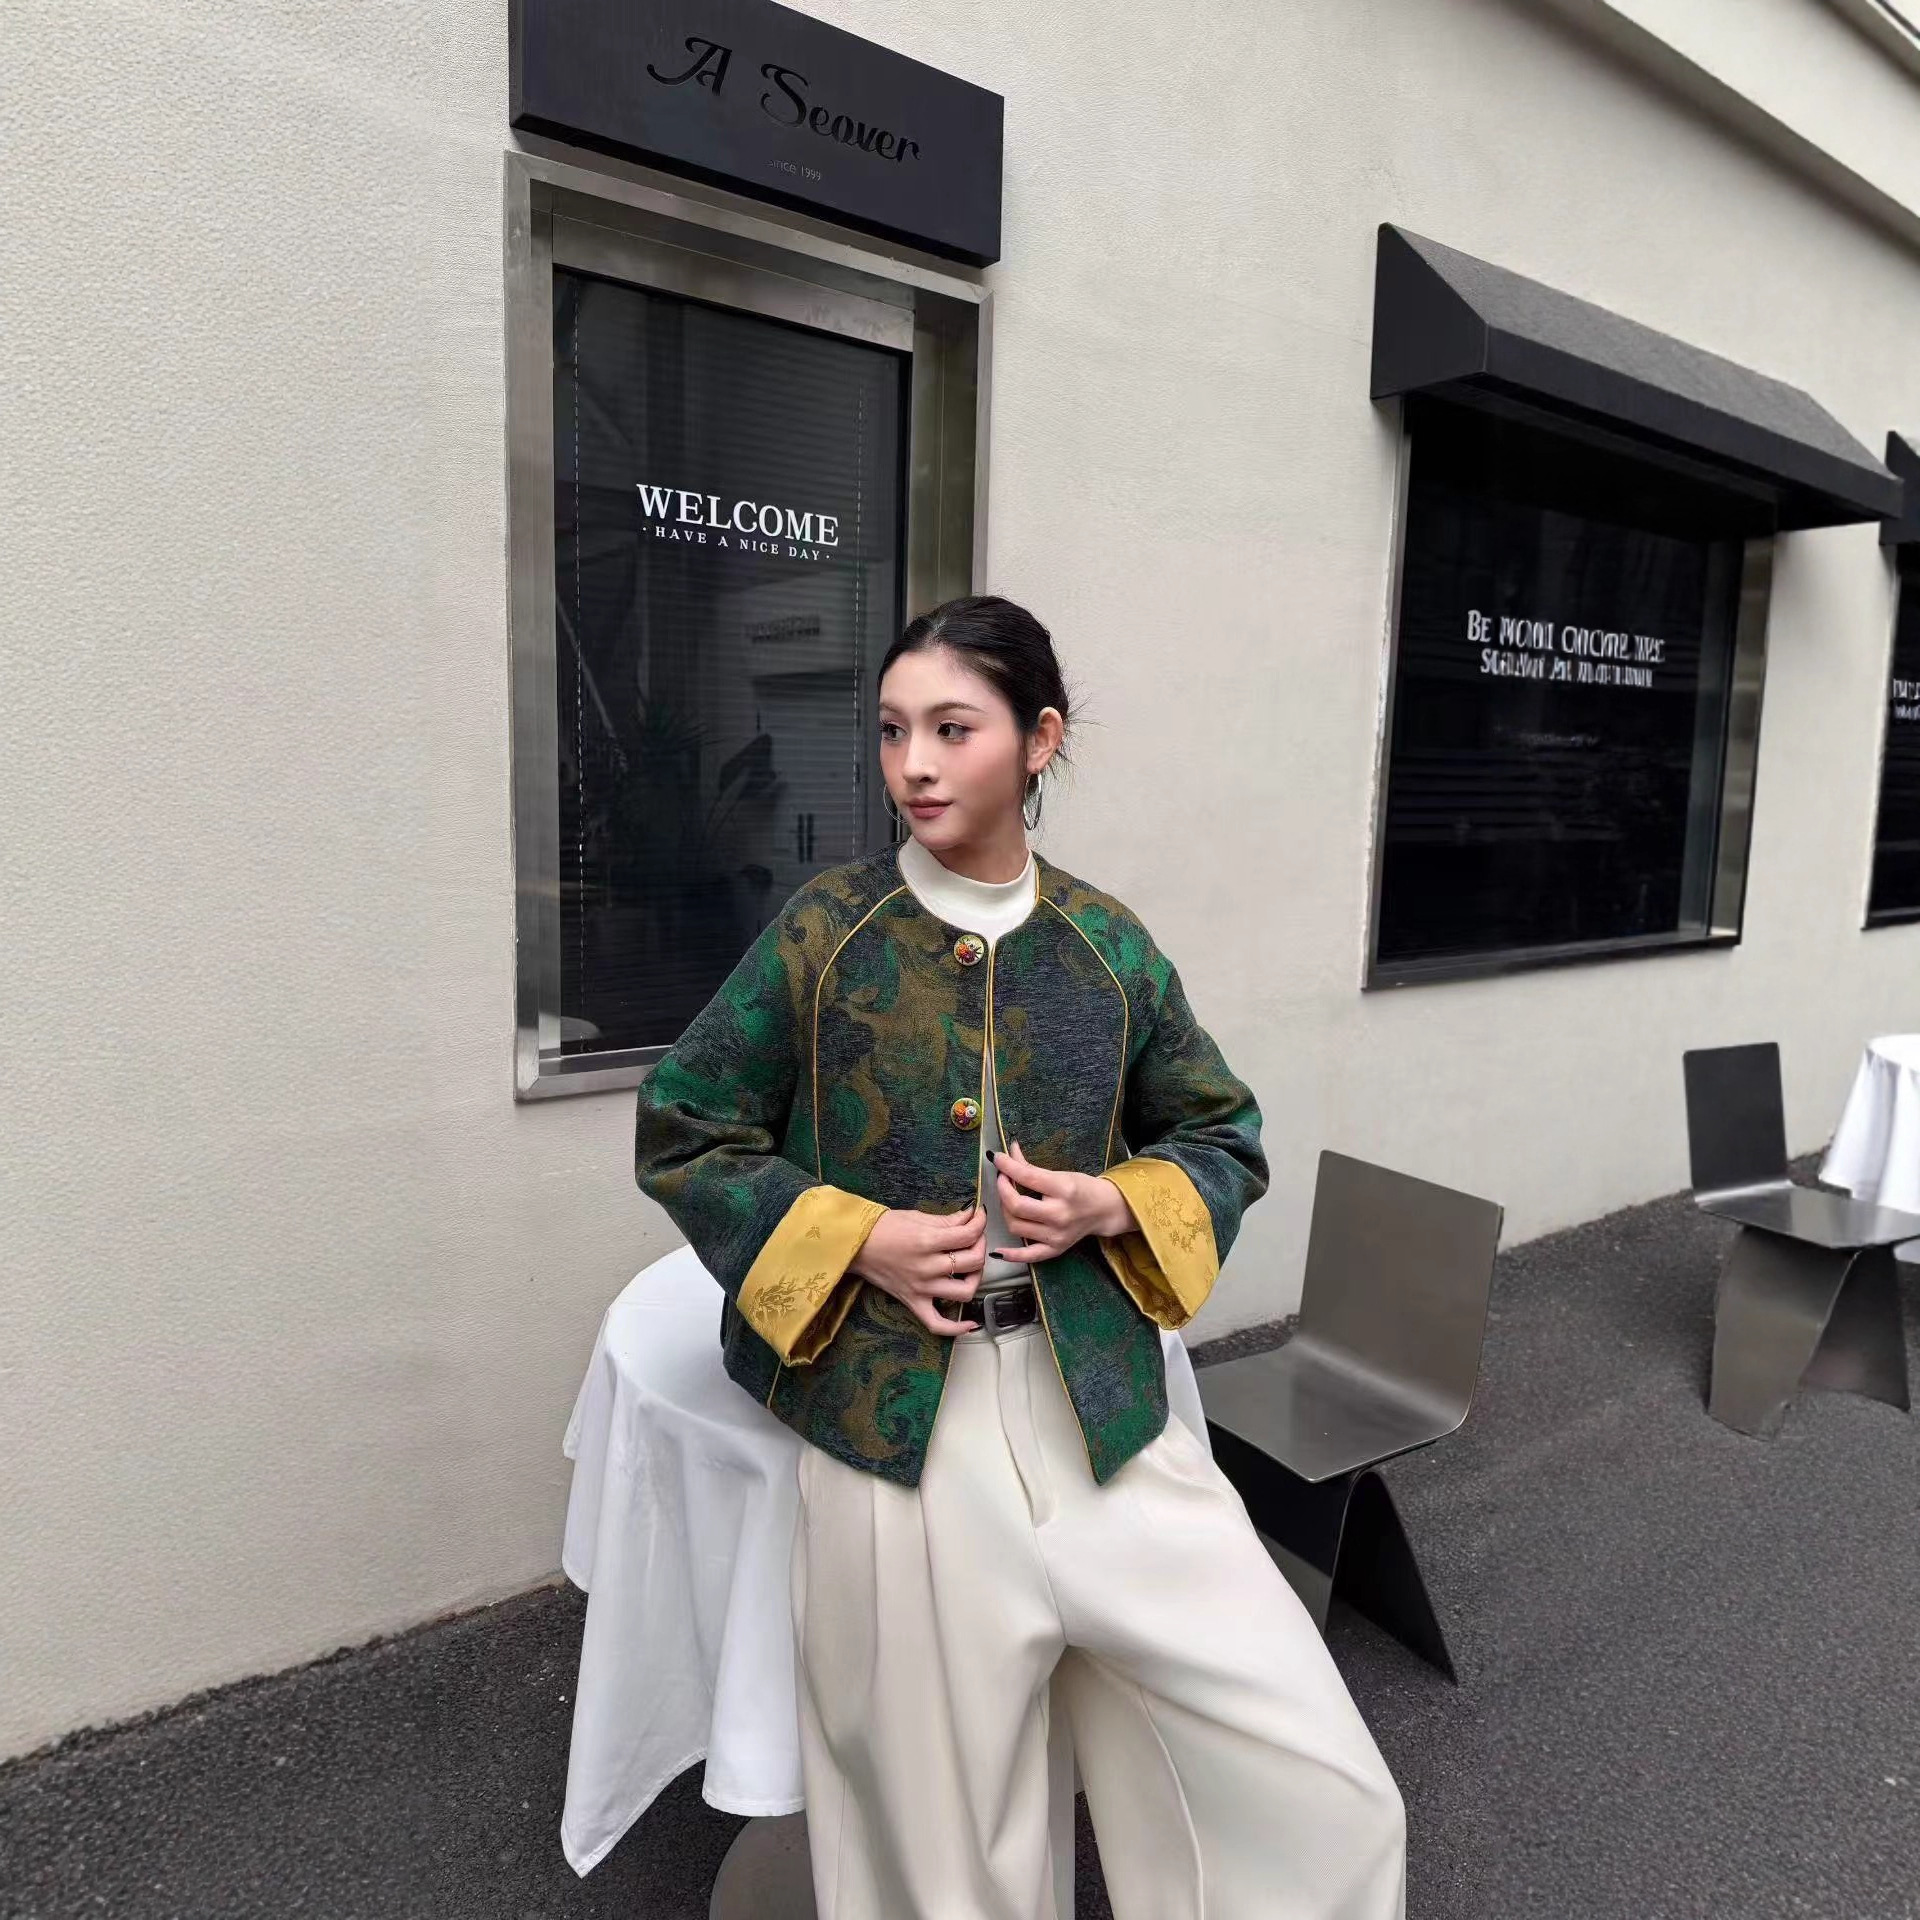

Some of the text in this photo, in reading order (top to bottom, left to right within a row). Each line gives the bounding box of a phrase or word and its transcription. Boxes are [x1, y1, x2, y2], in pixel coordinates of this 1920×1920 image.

[646, 36, 733, 97] A
[636, 483, 840, 547] WELCOME
[655, 526, 820, 561] HAVE A NICE DAY
